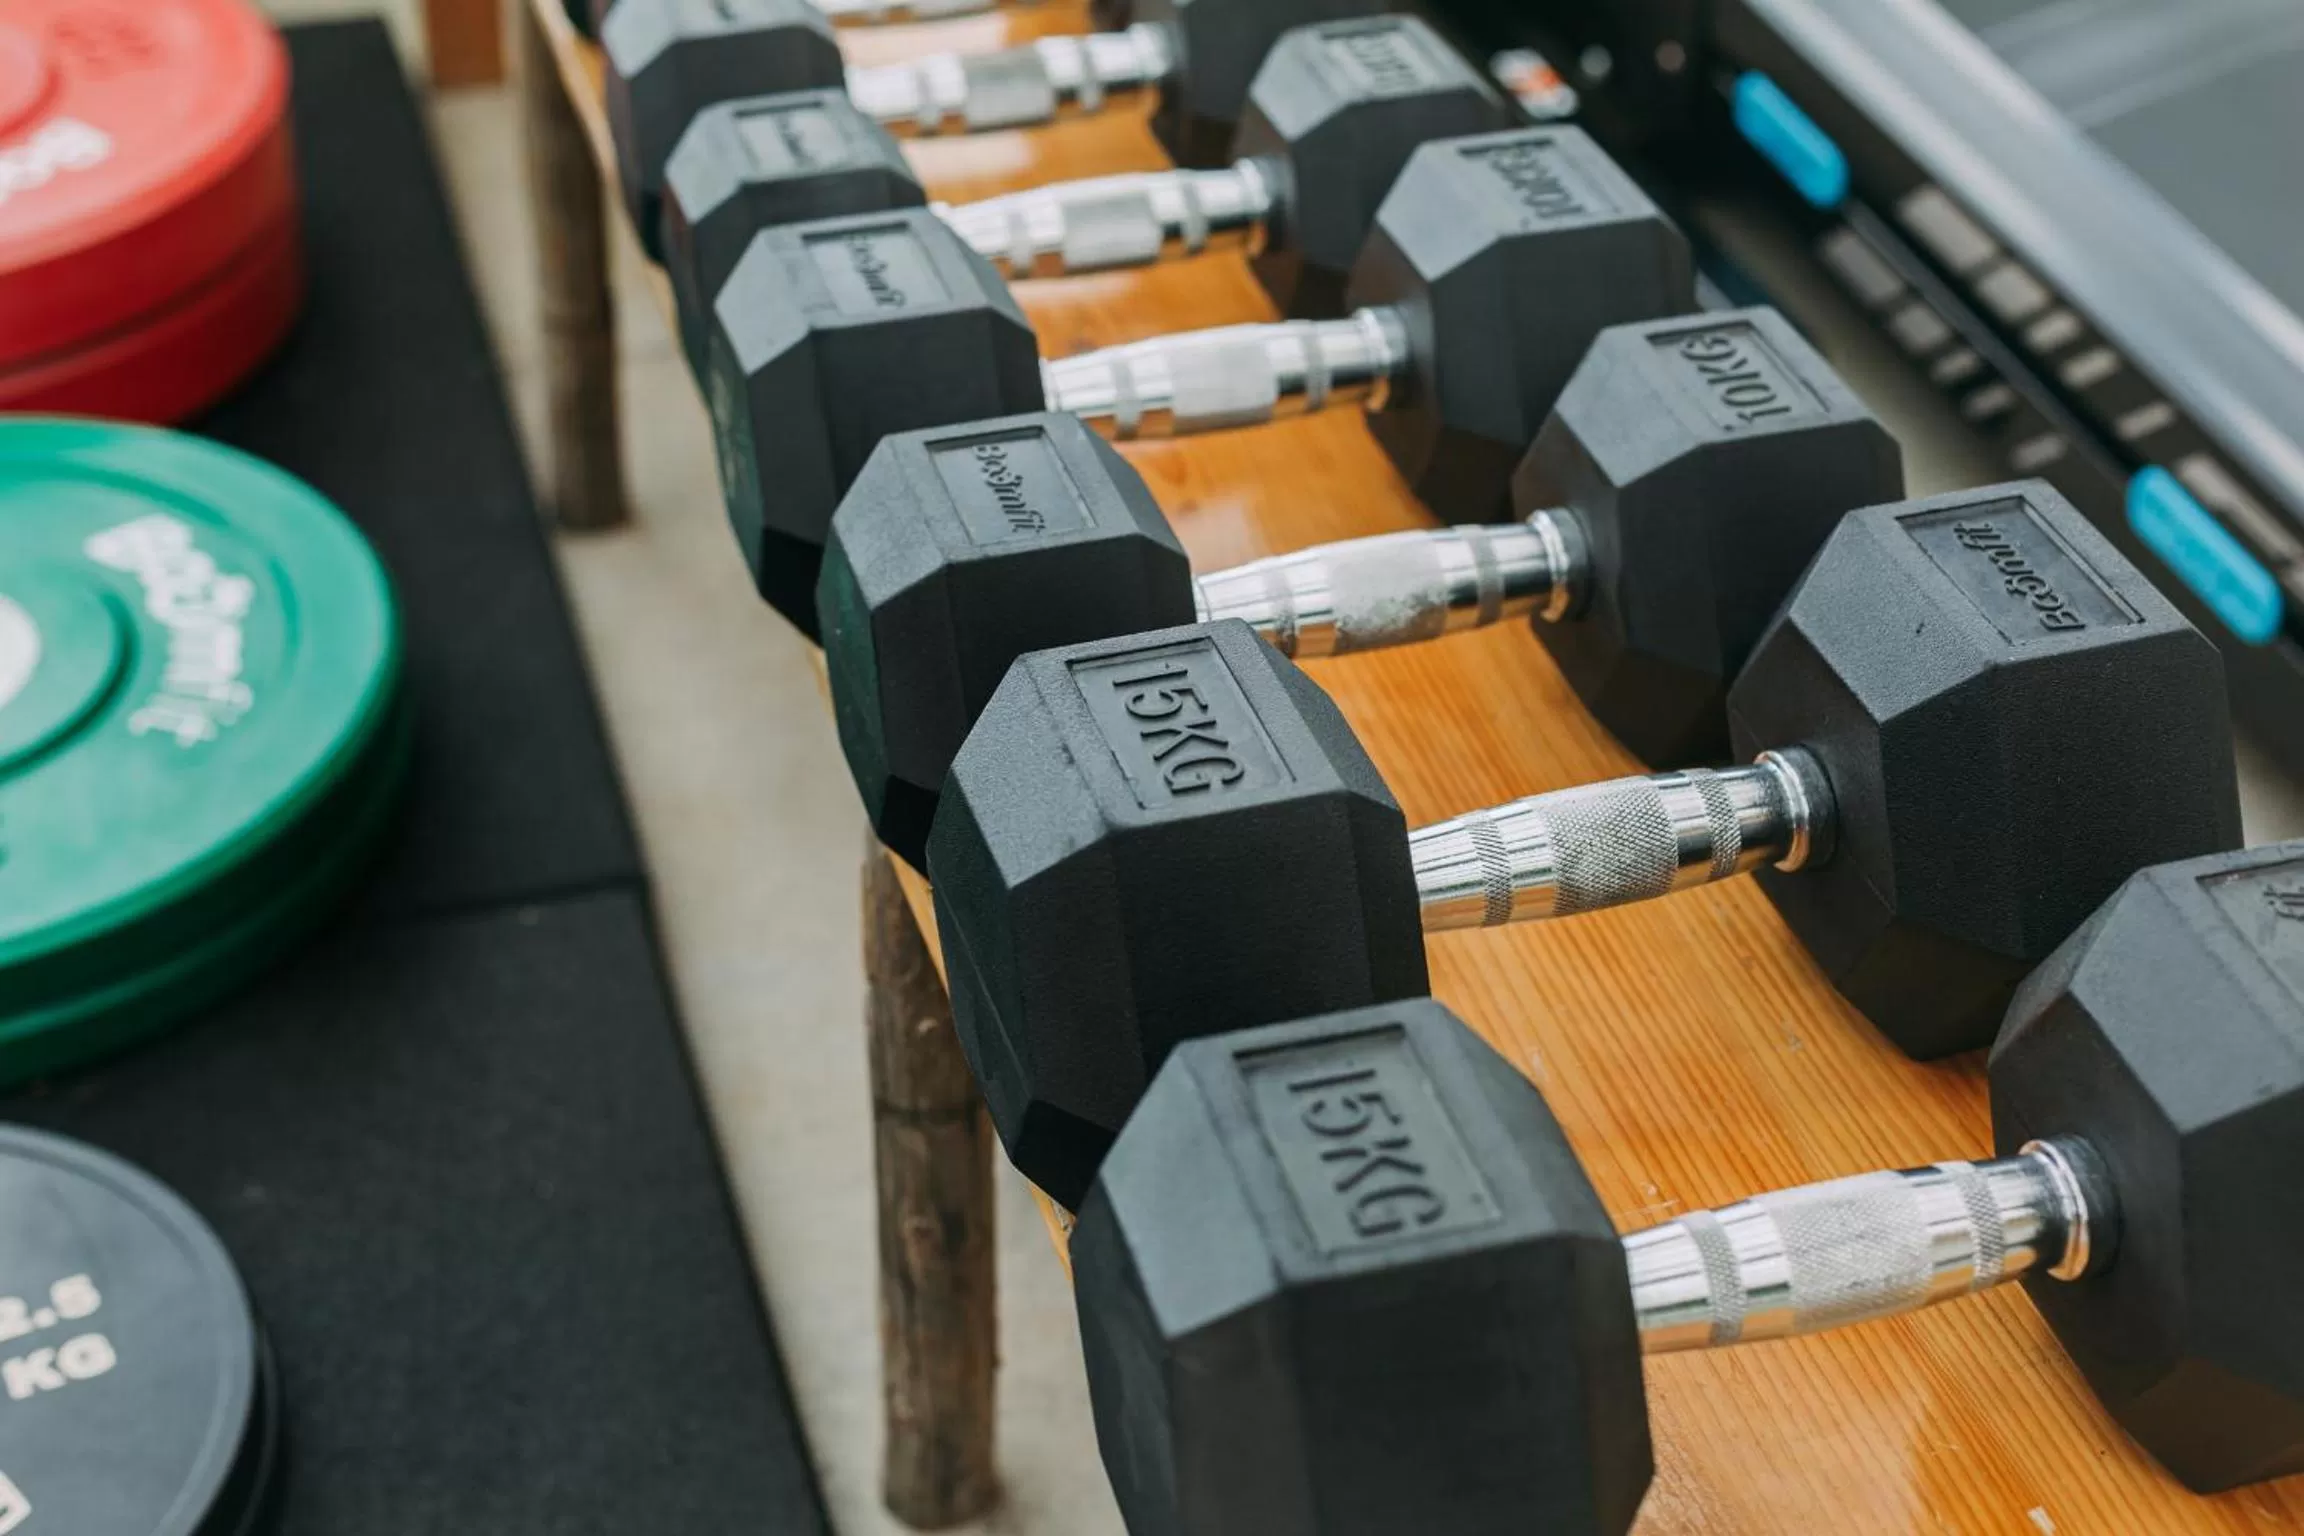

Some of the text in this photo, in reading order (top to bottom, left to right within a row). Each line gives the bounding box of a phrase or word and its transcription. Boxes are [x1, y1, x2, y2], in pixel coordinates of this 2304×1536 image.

[1684, 330, 1793, 426] 10KG
[1112, 662, 1245, 795] 15KG
[1287, 1065, 1444, 1239] 15KG
[2, 1333, 117, 1400] KG
